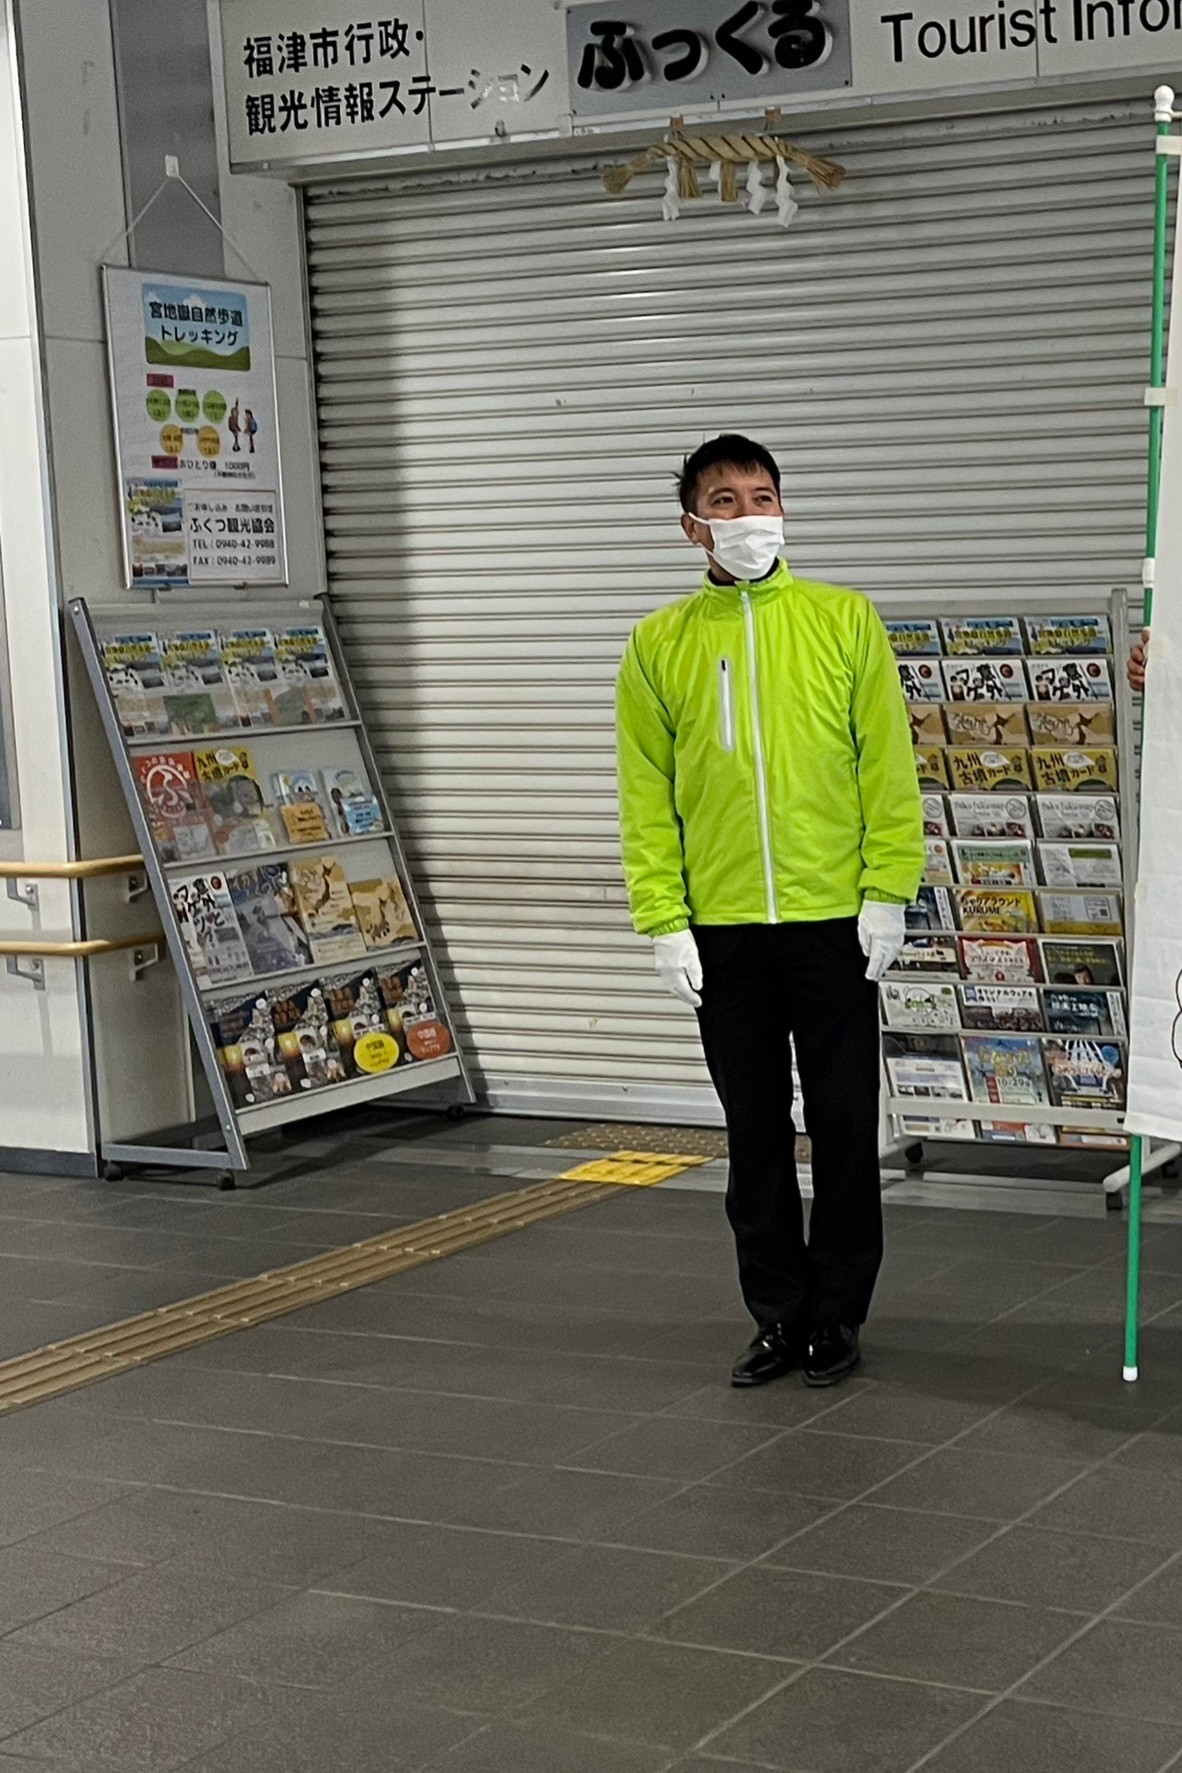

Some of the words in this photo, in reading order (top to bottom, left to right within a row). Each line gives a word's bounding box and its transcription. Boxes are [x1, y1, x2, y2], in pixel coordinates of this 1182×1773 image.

[577, 1, 828, 90] ふっくる
[881, 2, 1058, 62] Tourist
[160, 324, 238, 346] トレッキング
[190, 517, 275, 533] ふくつ観光協会
